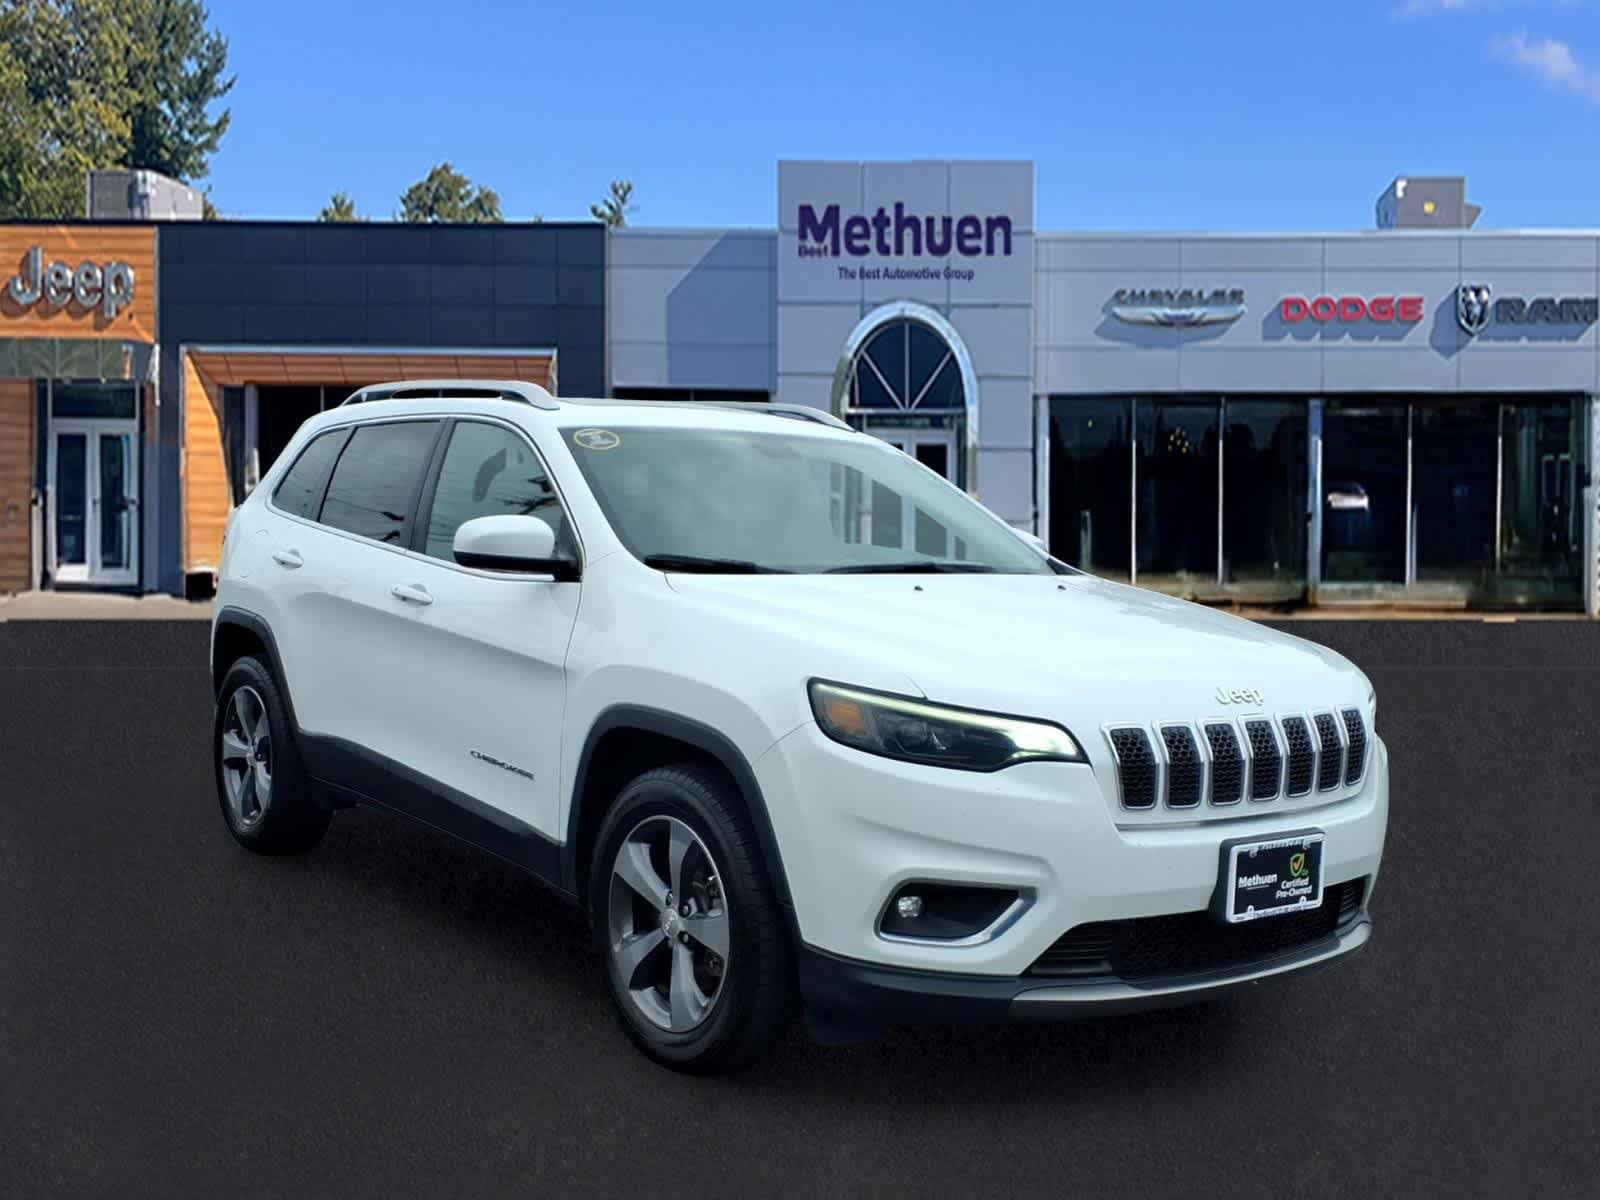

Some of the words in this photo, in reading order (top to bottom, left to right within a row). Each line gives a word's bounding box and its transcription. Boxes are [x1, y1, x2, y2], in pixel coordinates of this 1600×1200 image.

[798, 201, 1012, 257] Methuen
[9, 245, 135, 319] Jeep
[838, 266, 856, 280] The
[858, 266, 880, 280] Best
[883, 266, 941, 280] Automotive
[943, 266, 974, 282] Group
[1114, 288, 1244, 304] CHRYSLER
[1281, 296, 1423, 321] DODGE
[1495, 297, 1599, 323] RAM
[1215, 685, 1264, 706] Jeep
[1238, 874, 1278, 888] Methuen
[1281, 877, 1309, 889] Certified
[1276, 885, 1312, 899] Pre-Owned
